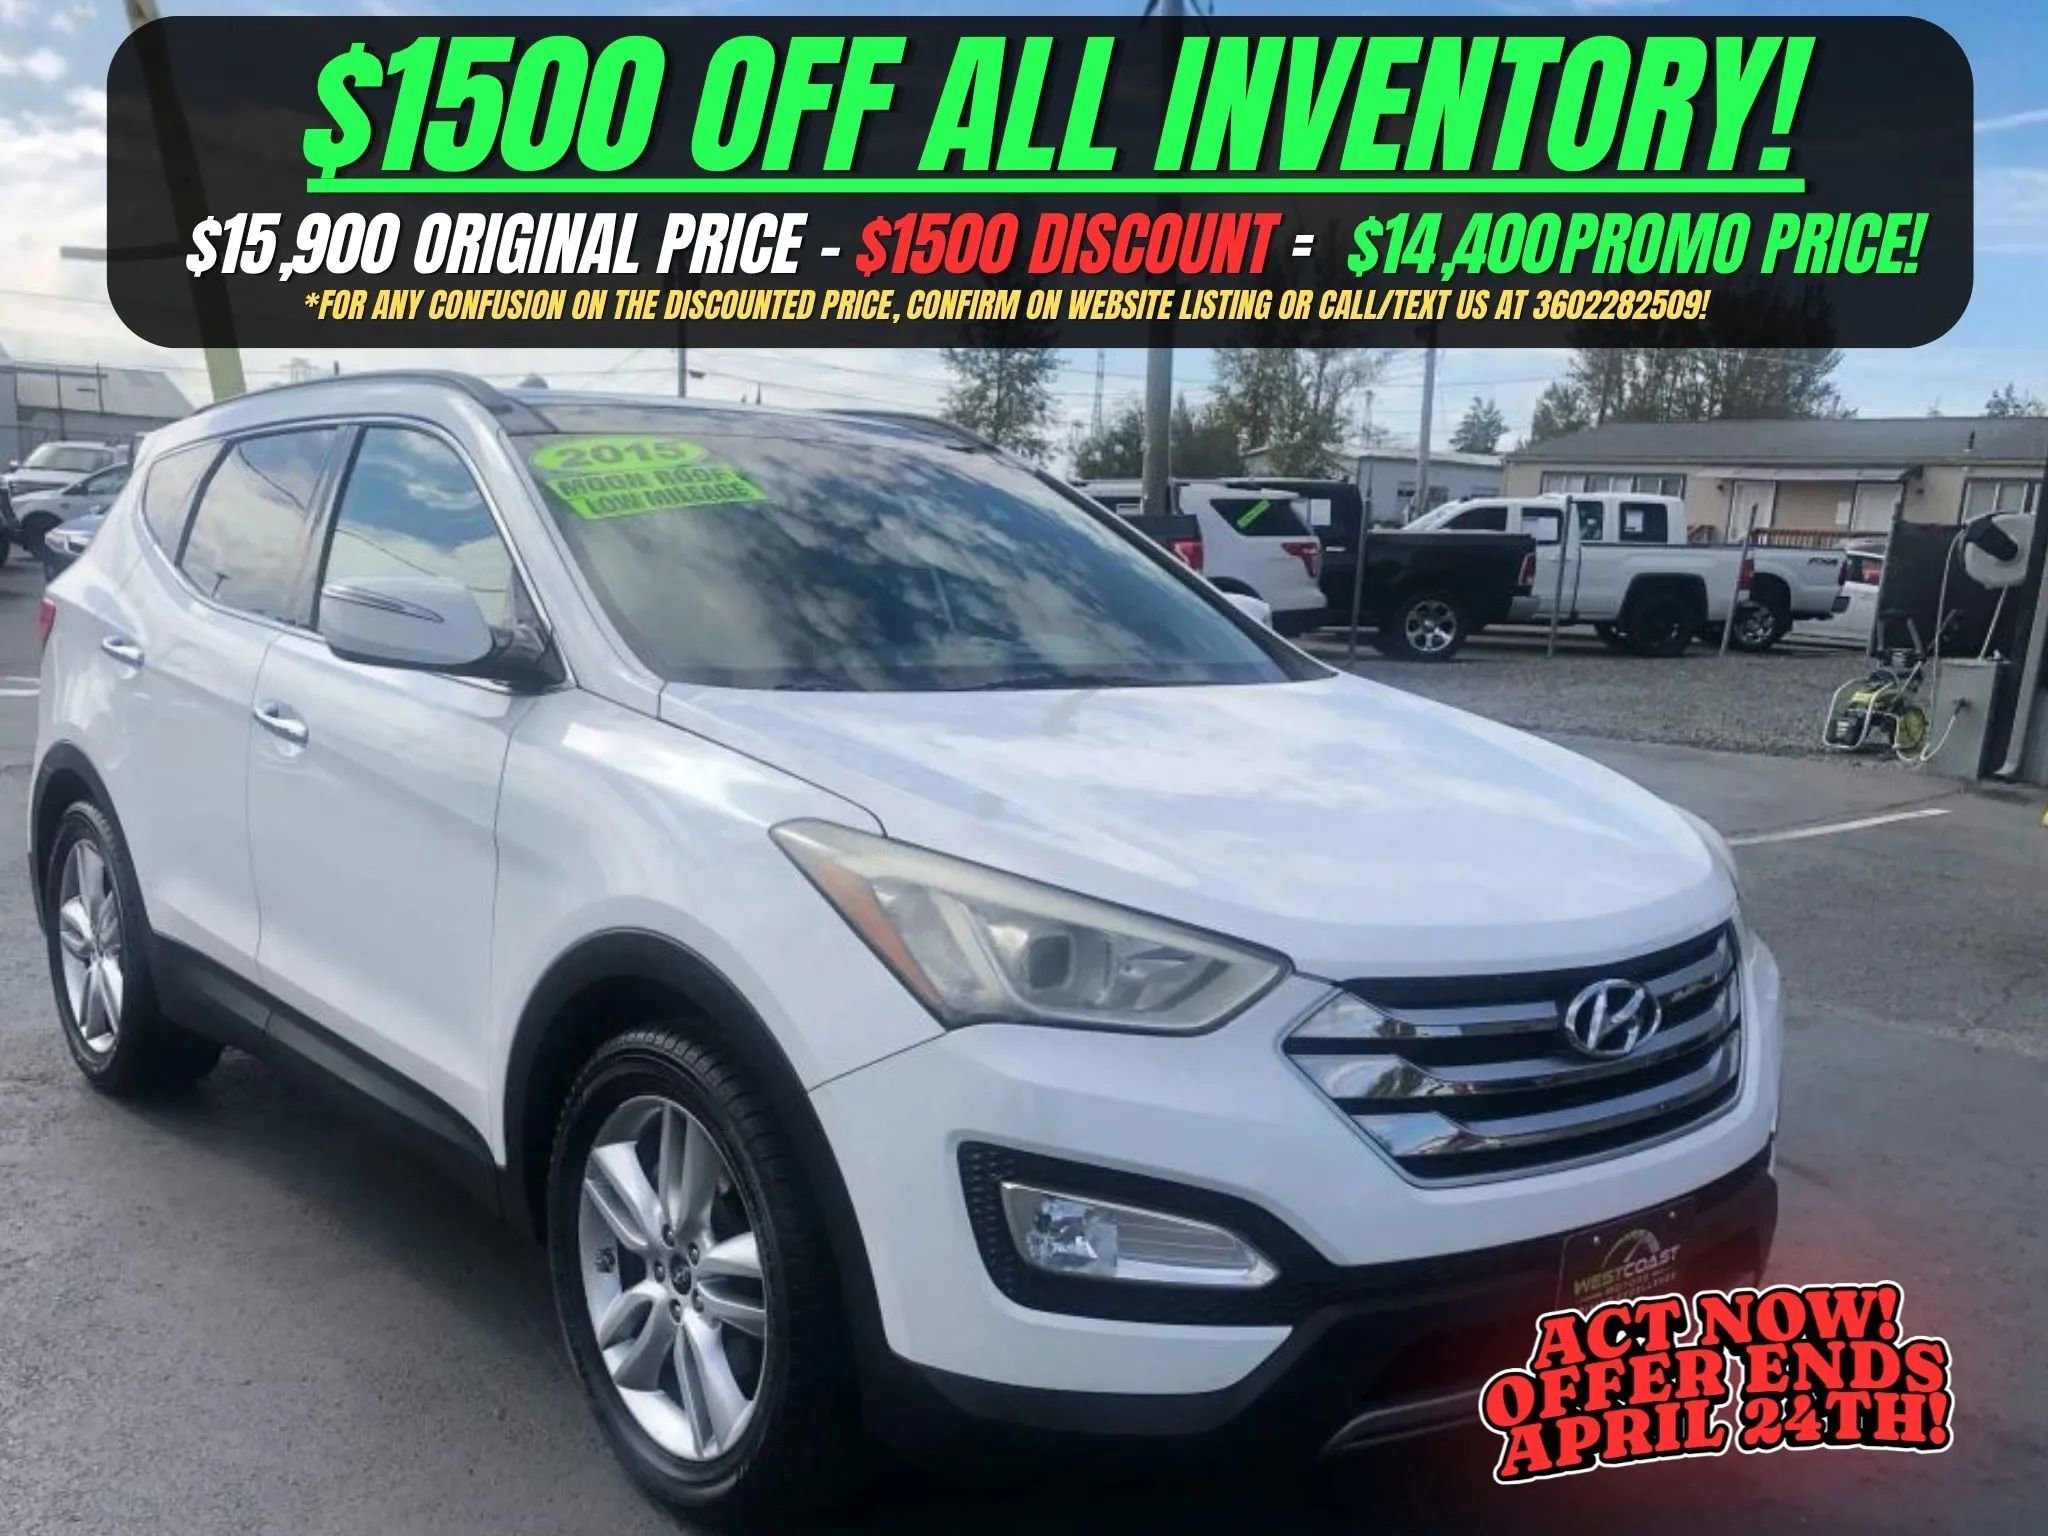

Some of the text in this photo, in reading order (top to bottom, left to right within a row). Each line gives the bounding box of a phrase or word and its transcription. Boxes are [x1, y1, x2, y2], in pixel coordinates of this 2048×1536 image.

[555, 440, 686, 467] 2015
[557, 465, 730, 498] MOON ROOF
[583, 481, 749, 514] LOW MILEAGE
